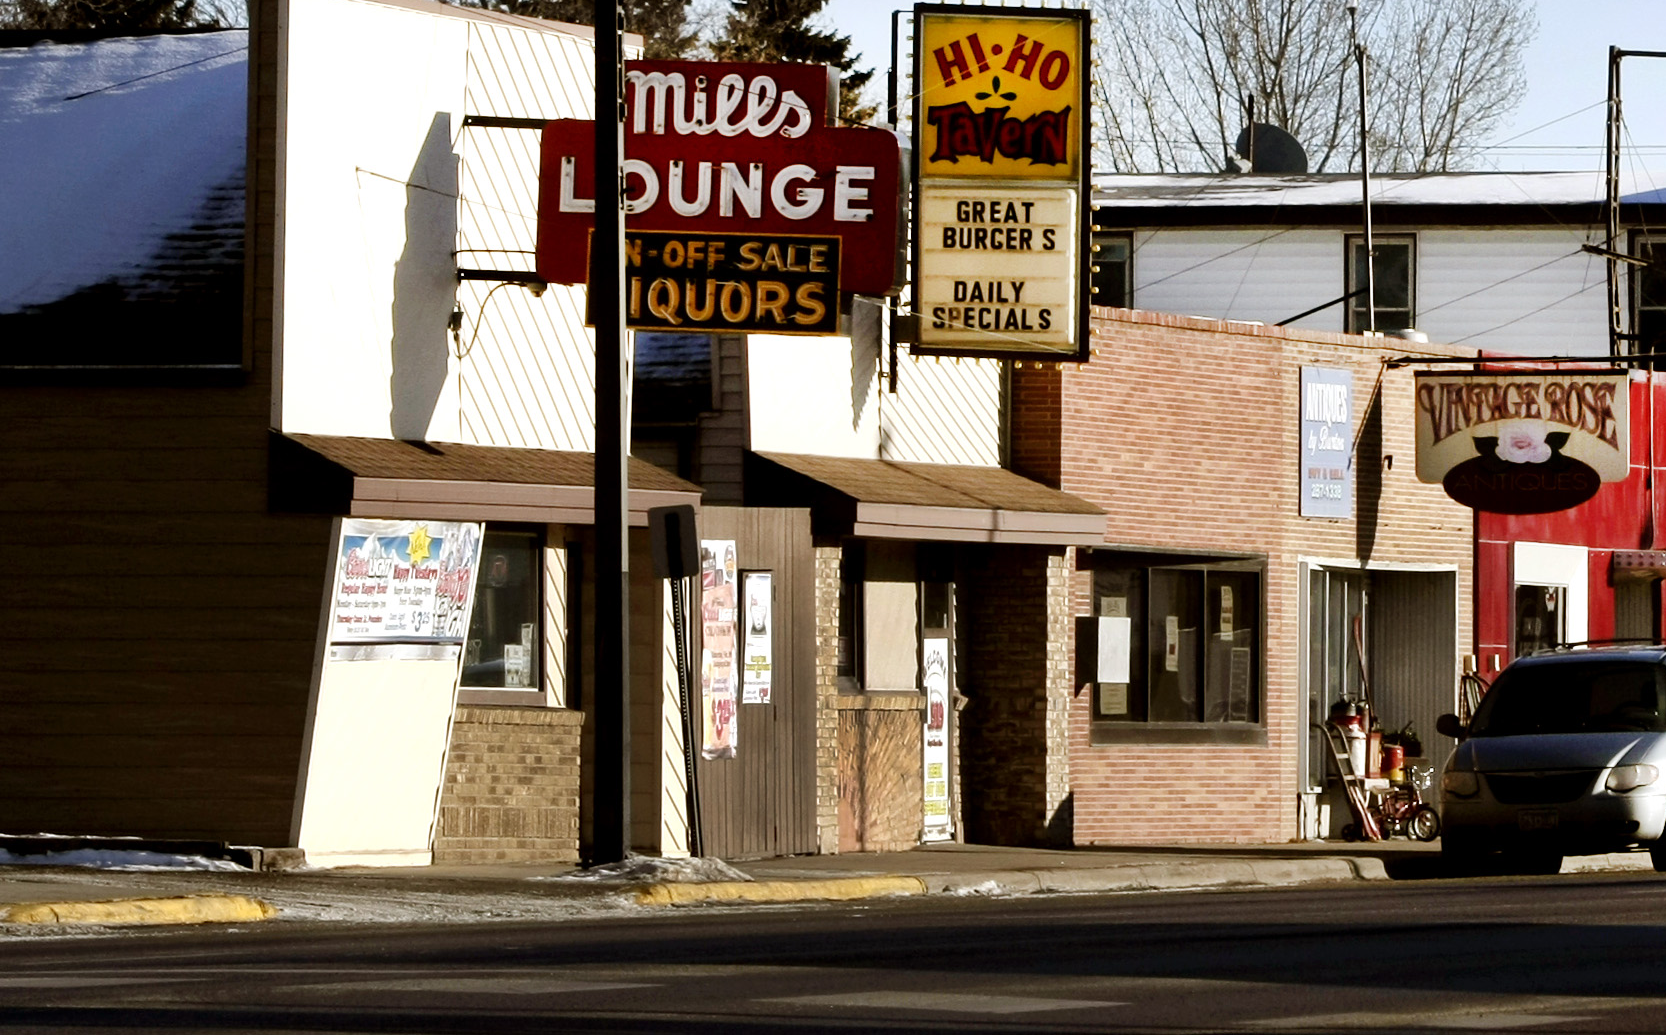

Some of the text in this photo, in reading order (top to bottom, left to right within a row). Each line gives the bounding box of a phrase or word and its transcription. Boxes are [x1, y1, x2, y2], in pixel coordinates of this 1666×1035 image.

[559, 156, 875, 222] LOUNGE
[956, 200, 1035, 224] GREAT
[737, 240, 830, 273] SALE
[629, 276, 827, 326] IQUORS
[953, 281, 1026, 304] DAILY
[932, 306, 1052, 331] SPECIALS
[1305, 382, 1347, 428] ANTIQUES
[1417, 381, 1619, 451] VINTAGE ROSE
[1453, 472, 1588, 491] ANTIQUES
